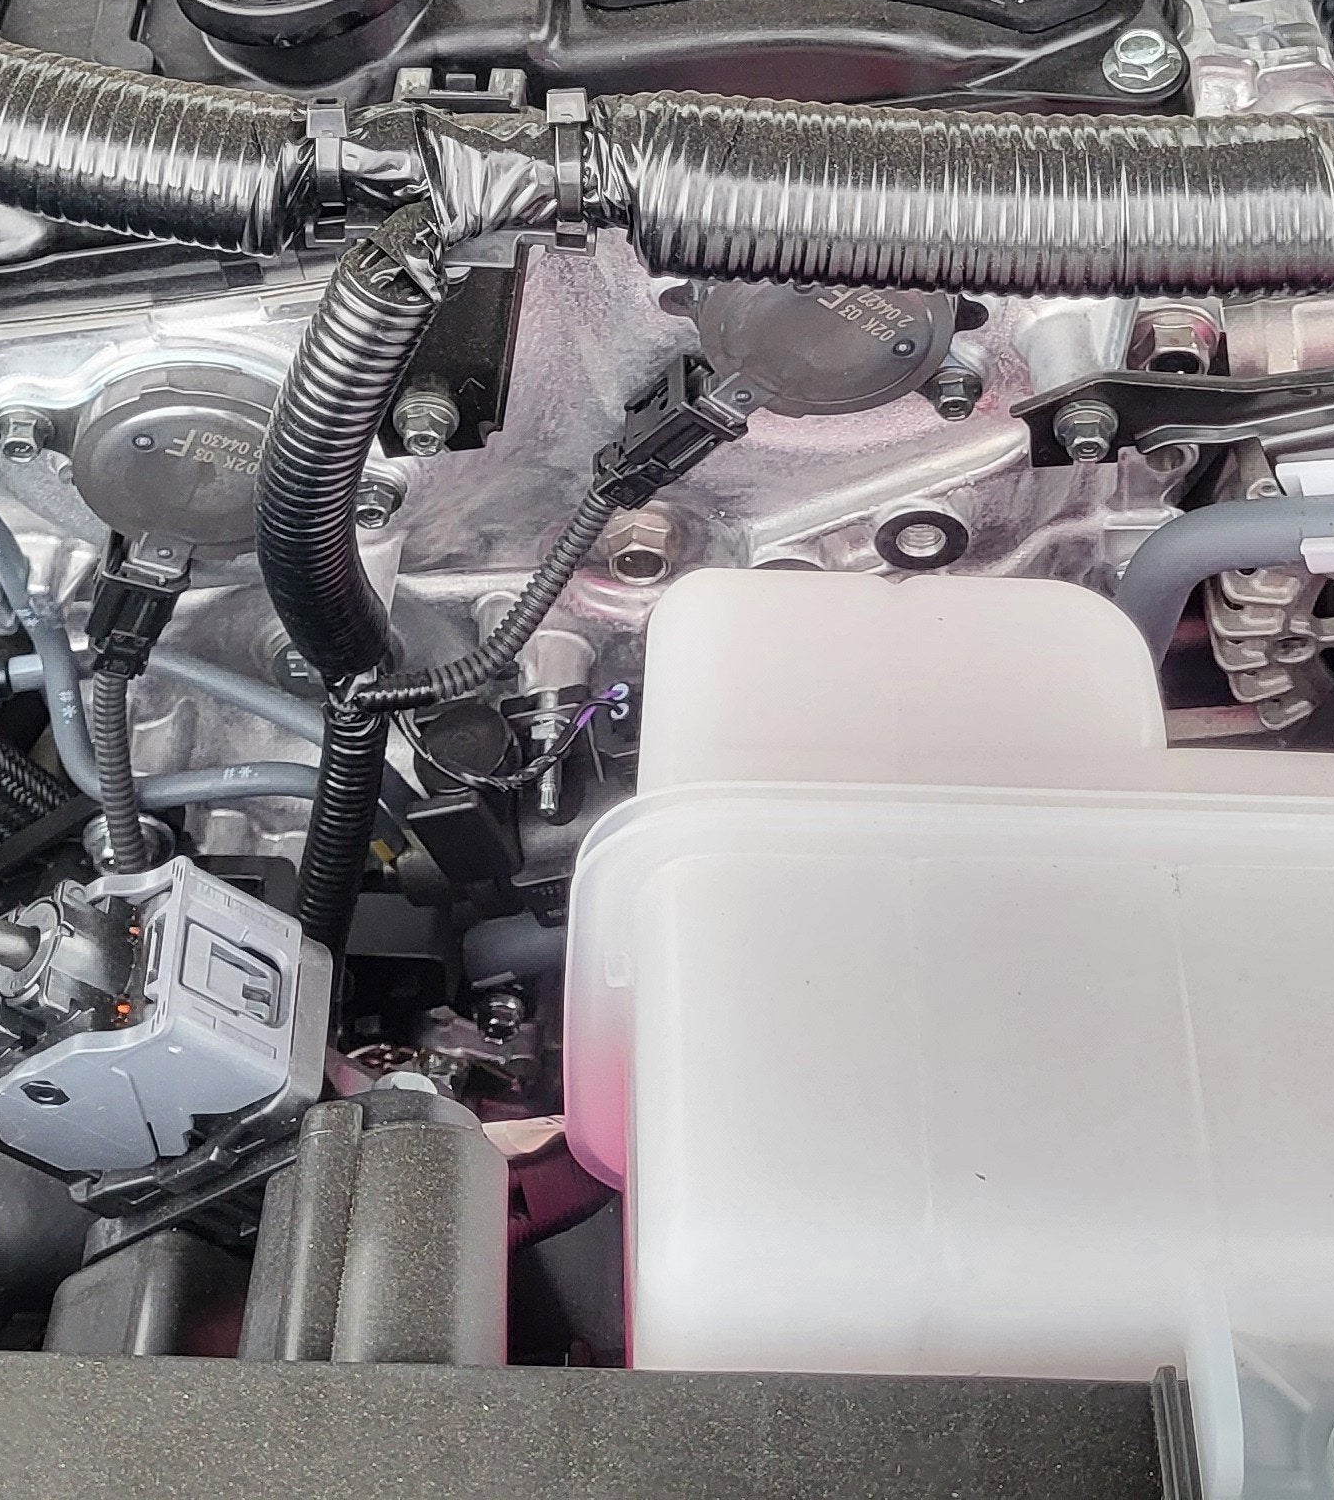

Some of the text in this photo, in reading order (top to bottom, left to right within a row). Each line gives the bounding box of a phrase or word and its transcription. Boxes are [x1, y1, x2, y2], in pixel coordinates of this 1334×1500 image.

[816, 288, 897, 342] 02K 03 F
[856, 291, 915, 328] 2 04427
[164, 429, 259, 475] 02K 03 F
[200, 431, 251, 455] 04430
